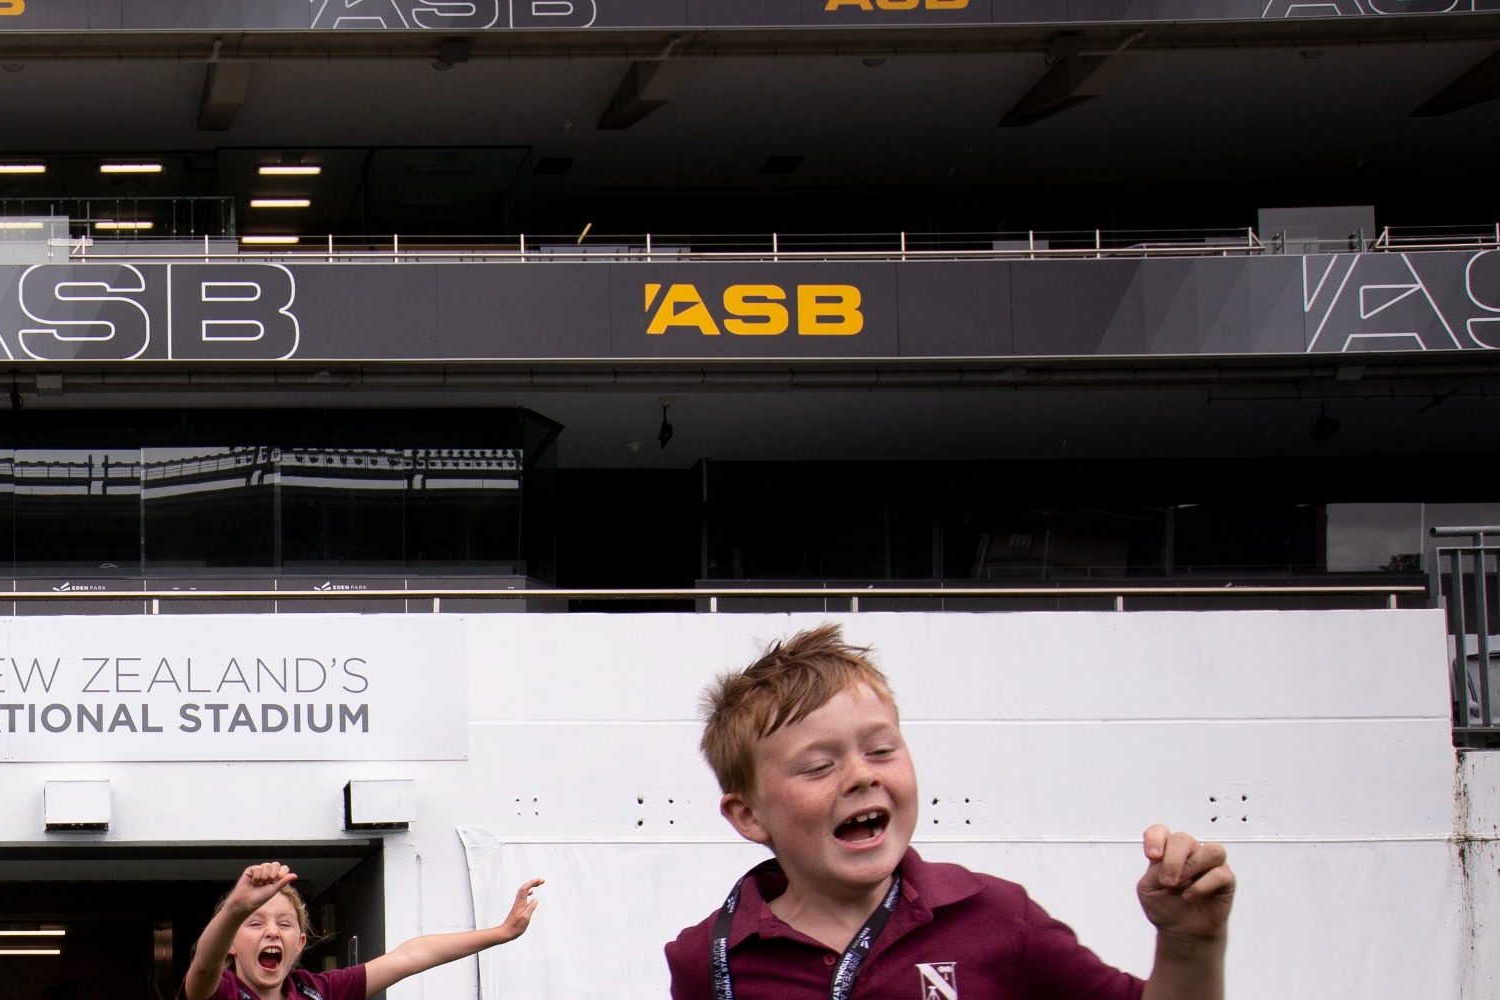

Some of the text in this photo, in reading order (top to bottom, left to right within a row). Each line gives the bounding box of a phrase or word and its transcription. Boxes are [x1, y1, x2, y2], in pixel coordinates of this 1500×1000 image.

[644, 282, 865, 337] ASB
[82, 657, 369, 694] ZEALAND'S
[179, 703, 369, 733] STADIUM
